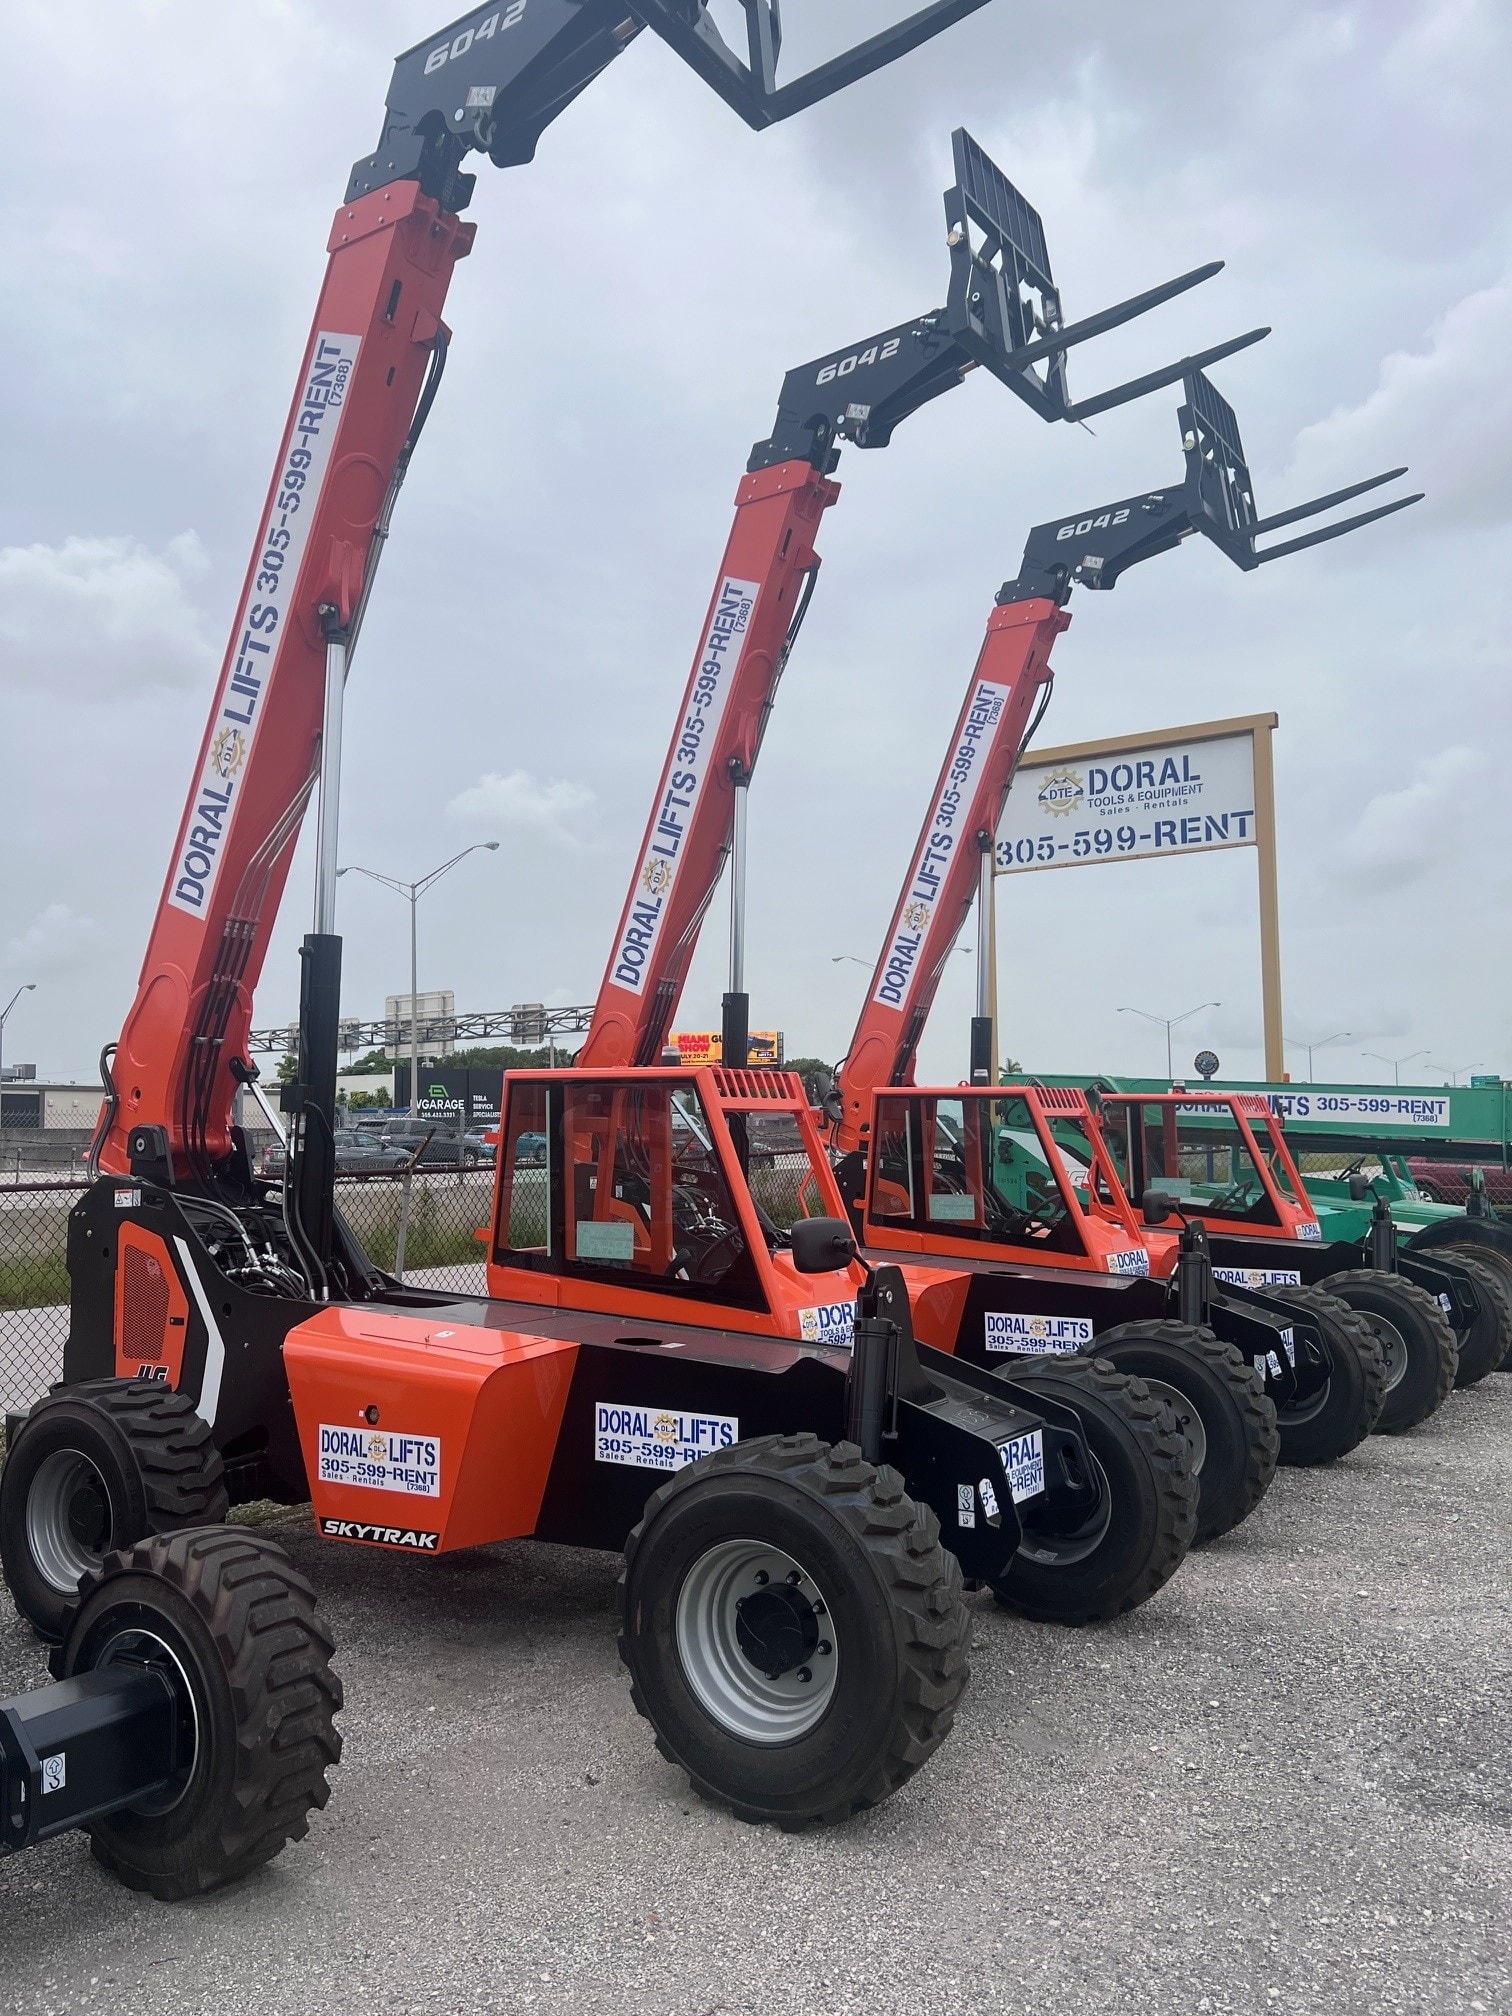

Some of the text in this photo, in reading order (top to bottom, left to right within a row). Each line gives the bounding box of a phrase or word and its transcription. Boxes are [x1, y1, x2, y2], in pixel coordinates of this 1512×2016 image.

[424, 0, 527, 75] 6042
[816, 338, 900, 386] 6042
[327, 359, 353, 407] (7368)
[1056, 508, 1131, 541] 6042
[175, 339, 341, 907] DORAL LIFTS 305-599-RENT
[733, 598, 753, 633] (7368)
[615, 582, 743, 986] DORAL LIFTS 305-599-RENT
[1049, 754, 1201, 800] DTE DORAL
[1087, 783, 1204, 809] TOOLS & EQUIPMENT
[1099, 797, 1189, 816] Sales Rentals
[878, 684, 996, 1004] DORAL LIFTS 305-599-RENT
[996, 810, 1254, 866] 305-599-RENT
[677, 1034, 710, 1044] MIAMI
[678, 1043, 711, 1052] SHOW
[411, 1099, 465, 1110] VGARAGE
[1266, 1094, 1309, 1117] IFTS
[1317, 1097, 1447, 1115] 305-599-RENT
[1412, 1113, 1438, 1124] (7368)
[1117, 1250, 1148, 1269] DORAL
[1262, 1273, 1298, 1286] LIFTS
[820, 1327, 840, 1338] TOOLS
[987, 1315, 1030, 1335] DORAL
[1050, 1318, 1089, 1339] LIFTS
[1017, 1345, 1046, 1353] Rentals
[598, 1408, 654, 1439] DORAL
[679, 1417, 733, 1447] LIFTS
[322, 1429, 368, 1458] DORAL
[389, 1437, 436, 1467] LIFTS
[599, 1450, 674, 1468] Sales Rentals
[321, 1457, 438, 1486] 305-599-RENT
[322, 1470, 385, 1487] Sales Rentals
[1011, 1458, 1043, 1480] EQUIPMENT
[406, 1481, 430, 1494] (7368)
[324, 1520, 438, 1549] SKYTRAK
